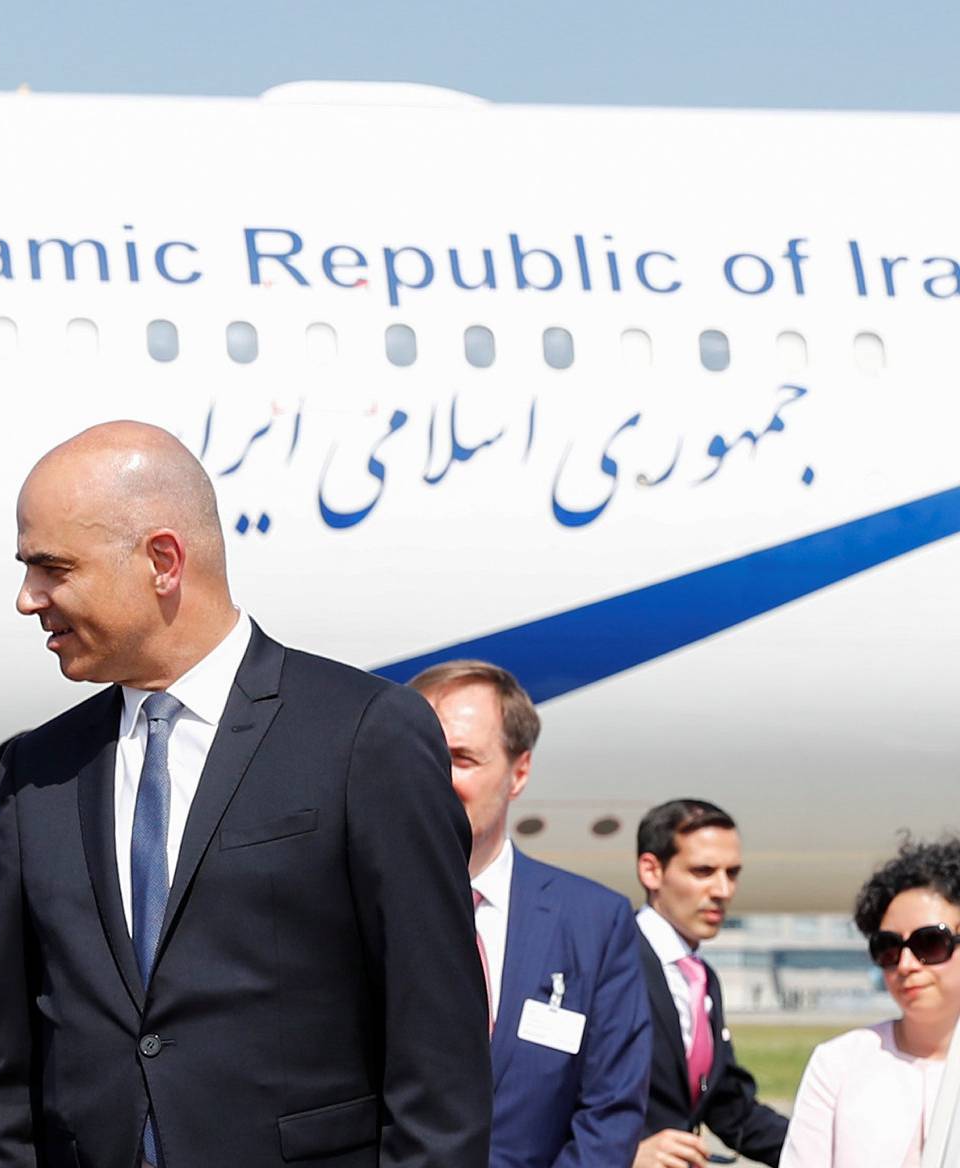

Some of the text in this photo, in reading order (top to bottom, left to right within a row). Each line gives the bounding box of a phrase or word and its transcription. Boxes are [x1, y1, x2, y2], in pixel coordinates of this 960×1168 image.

[243, 227, 683, 307] Republic
[723, 238, 809, 296] of
[180, 384, 816, 536] جمهوری اسلامی ایرا
